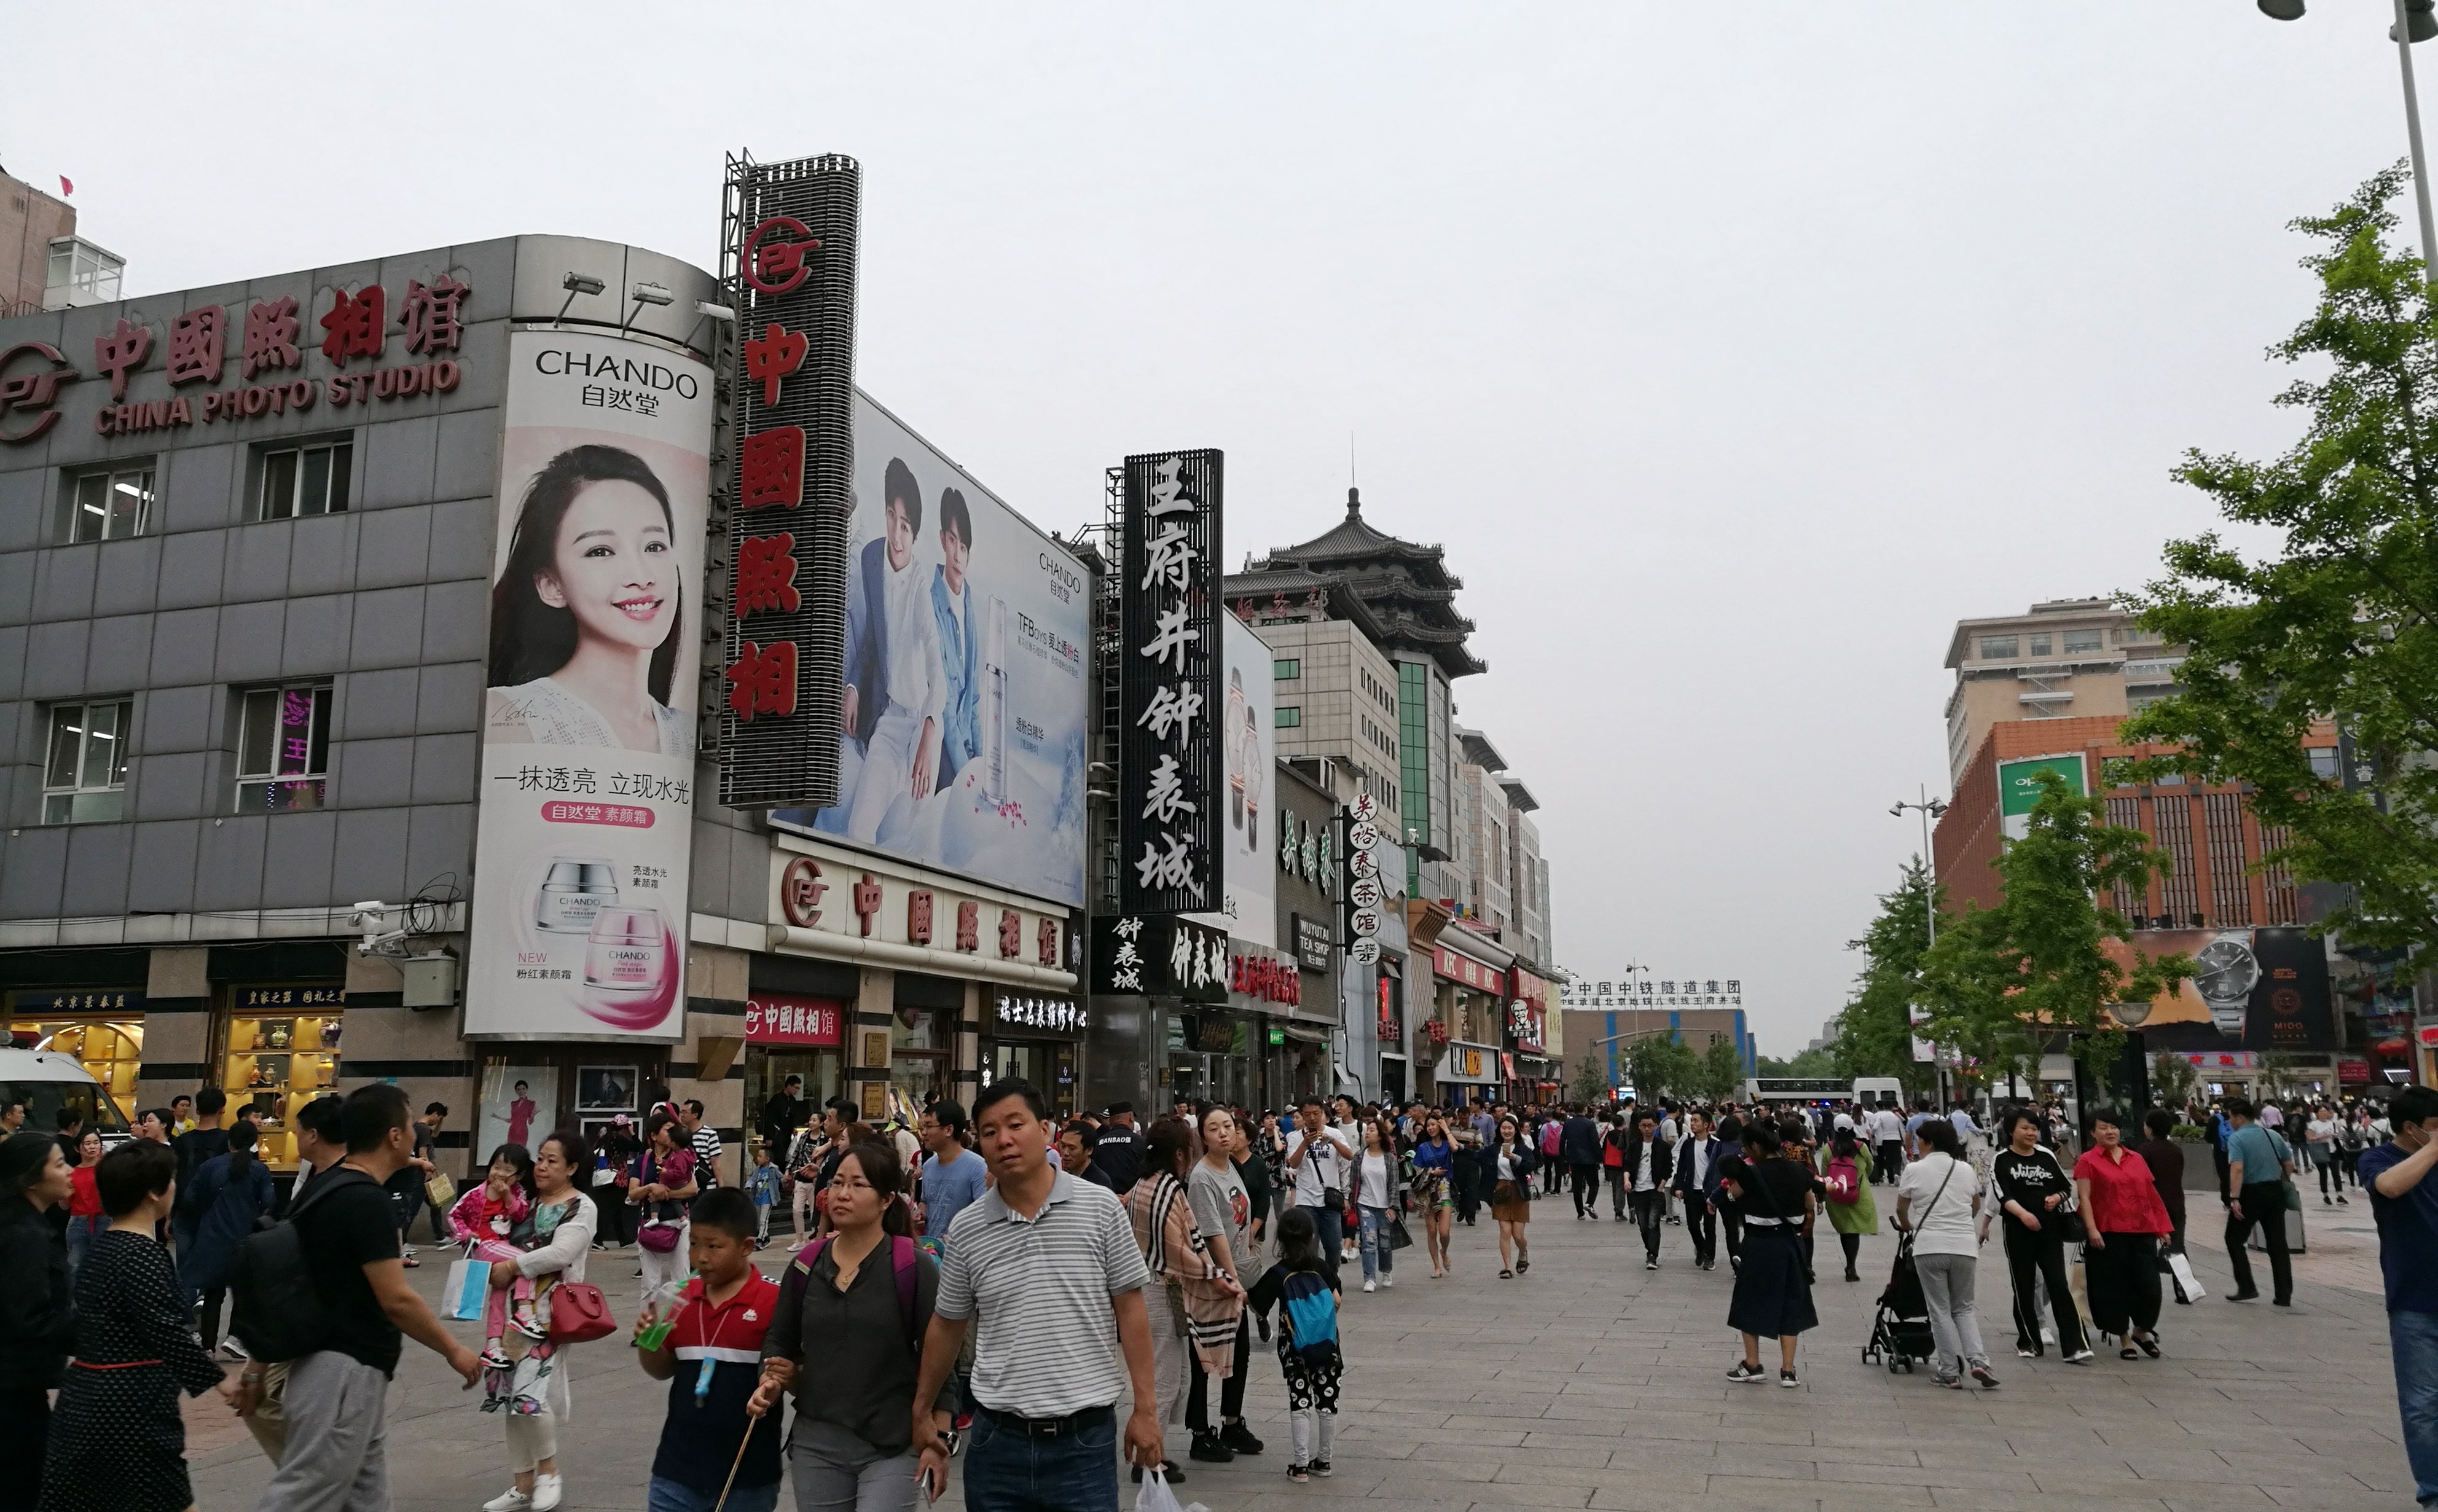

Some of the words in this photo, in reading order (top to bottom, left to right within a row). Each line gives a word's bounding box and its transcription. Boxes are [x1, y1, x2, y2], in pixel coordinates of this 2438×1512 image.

[95, 273, 471, 402] 中國照相馆
[536, 350, 698, 399] CHANDO
[95, 396, 192, 437] CHINA
[202, 379, 316, 423] PHOTO
[328, 359, 461, 407] STUDIO
[582, 383, 659, 417] 自然堂
[727, 323, 810, 722] 中國照相
[1039, 552, 1081, 594] CHANDO
[1048, 632, 1079, 664] 爱上透粉白
[1134, 457, 1204, 902] 王府井钟表城
[494, 765, 596, 794] 一抹透亮
[608, 771, 689, 805] 立现水光
[552, 804, 601, 821] 自然堂
[605, 807, 647, 825] 素颜霜
[633, 864, 667, 878] 亮透水光
[1353, 793, 1379, 931] 吴裕泰茶馆
[632, 877, 659, 889] 素颜霜
[1299, 919, 1329, 941] WUYUTAI
[518, 953, 547, 963] NEW
[609, 950, 650, 960] CHANDO
[1111, 917, 1144, 992] 钟表城
[1299, 935, 1314, 952] TEA
[1315, 942, 1330, 955] SHOP
[1354, 944, 1377, 952] 二楼
[1358, 953, 1374, 962] 2F
[1170, 926, 1229, 993] 钟表城
[1444, 950, 1456, 976] KFC
[517, 969, 571, 981] 粉红素颜霜
[1484, 968, 1495, 990] KFC
[1579, 980, 1741, 996] 中国中铁隧道集团
[1000, 995, 1087, 1033] 瑞士名表维修中心
[1452, 1047, 1467, 1075] HLA
